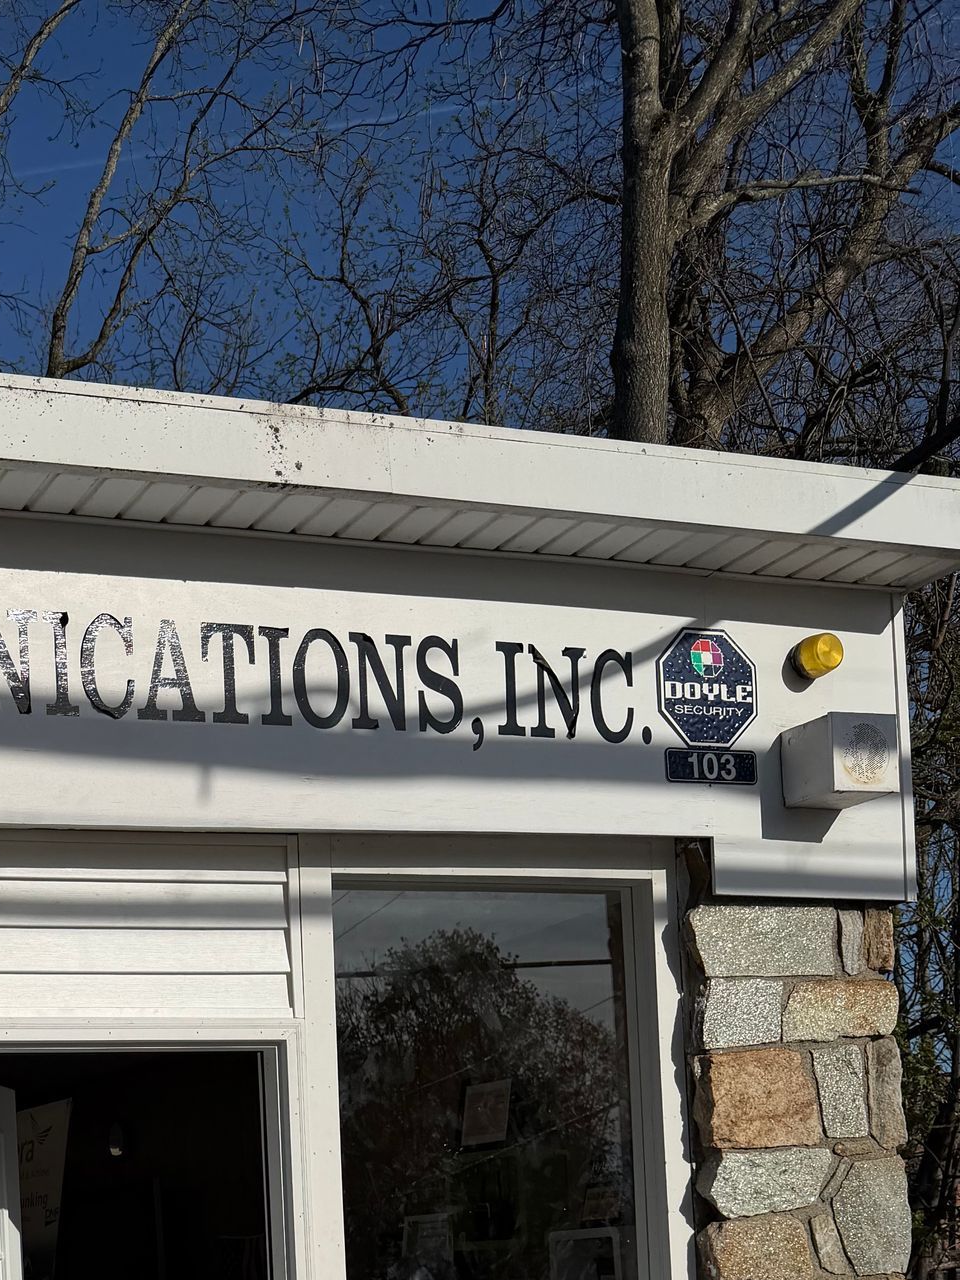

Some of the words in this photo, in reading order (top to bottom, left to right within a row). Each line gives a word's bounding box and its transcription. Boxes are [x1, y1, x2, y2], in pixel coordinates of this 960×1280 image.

[664, 681, 753, 704] DOYLE
[674, 704, 744, 717] SECURITY
[688, 753, 737, 781] 103
